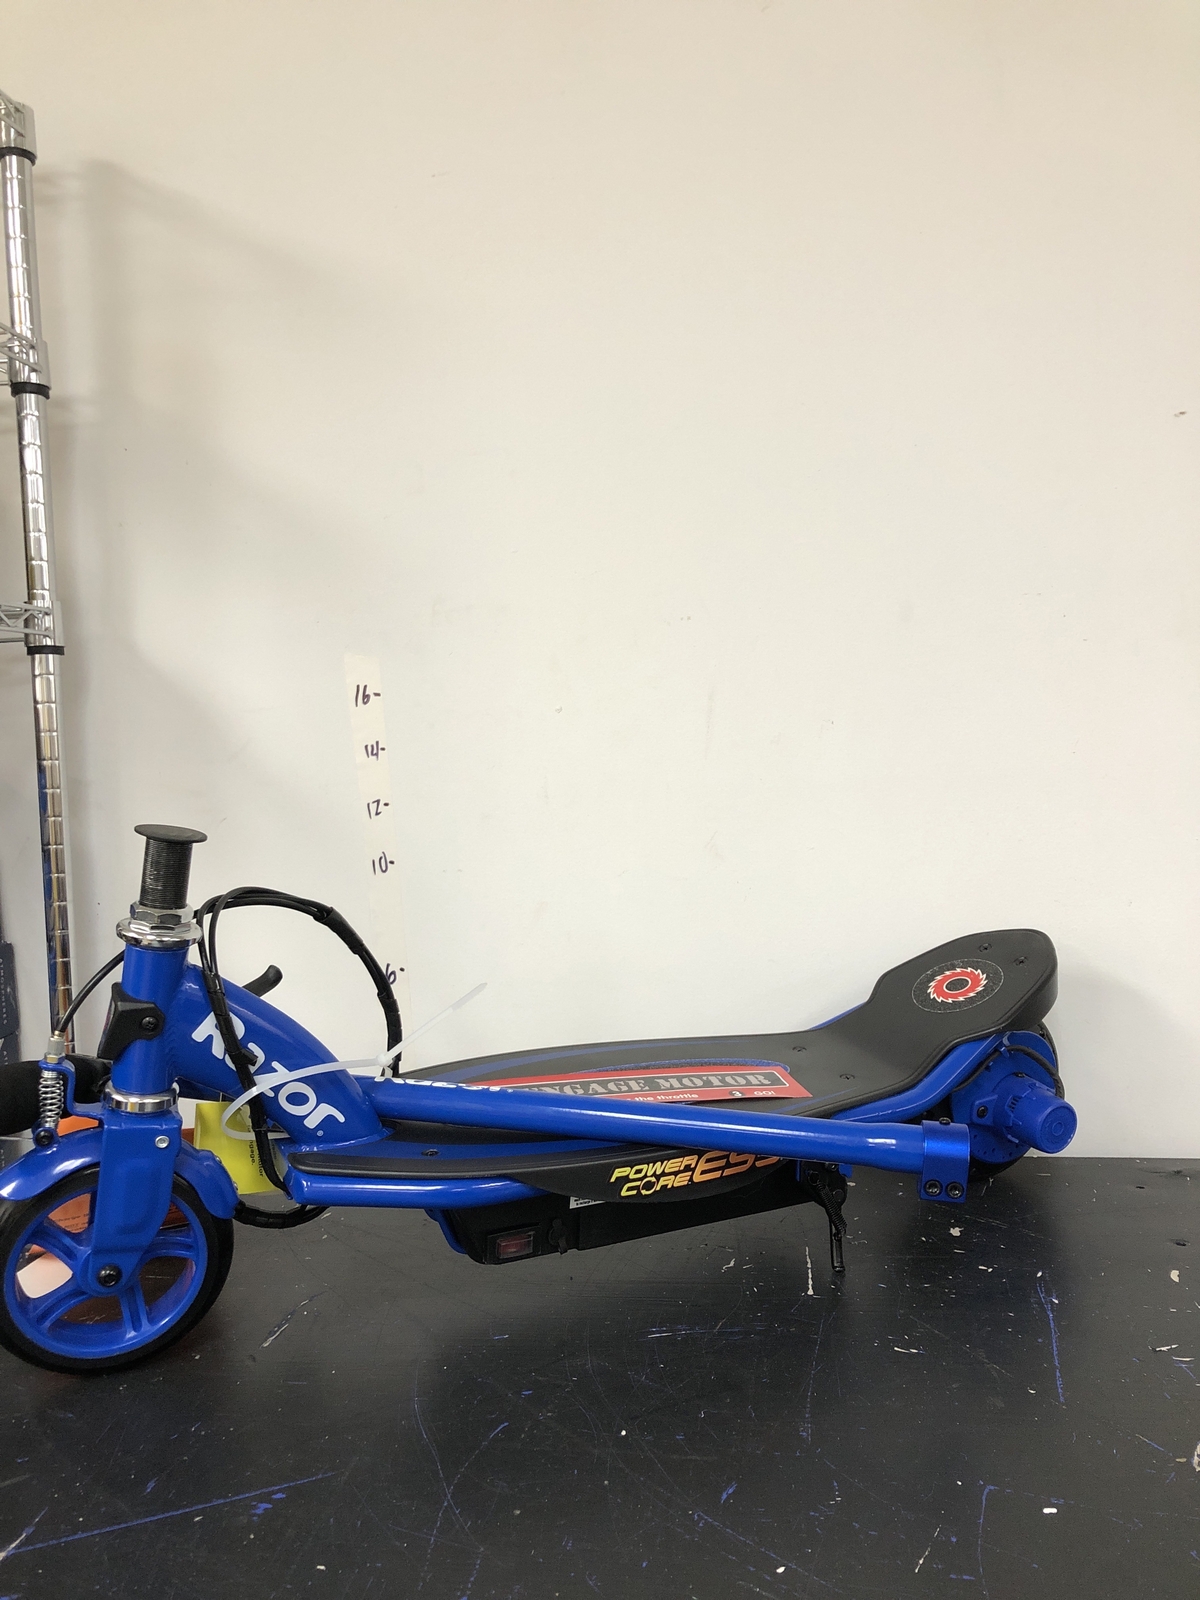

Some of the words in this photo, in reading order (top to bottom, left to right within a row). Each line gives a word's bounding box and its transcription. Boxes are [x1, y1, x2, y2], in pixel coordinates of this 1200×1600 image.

[654, 1072, 772, 1090] MOTOR
[656, 1093, 699, 1102] throttle
[609, 1154, 698, 1183] POWER
[620, 1172, 694, 1197] CORE
